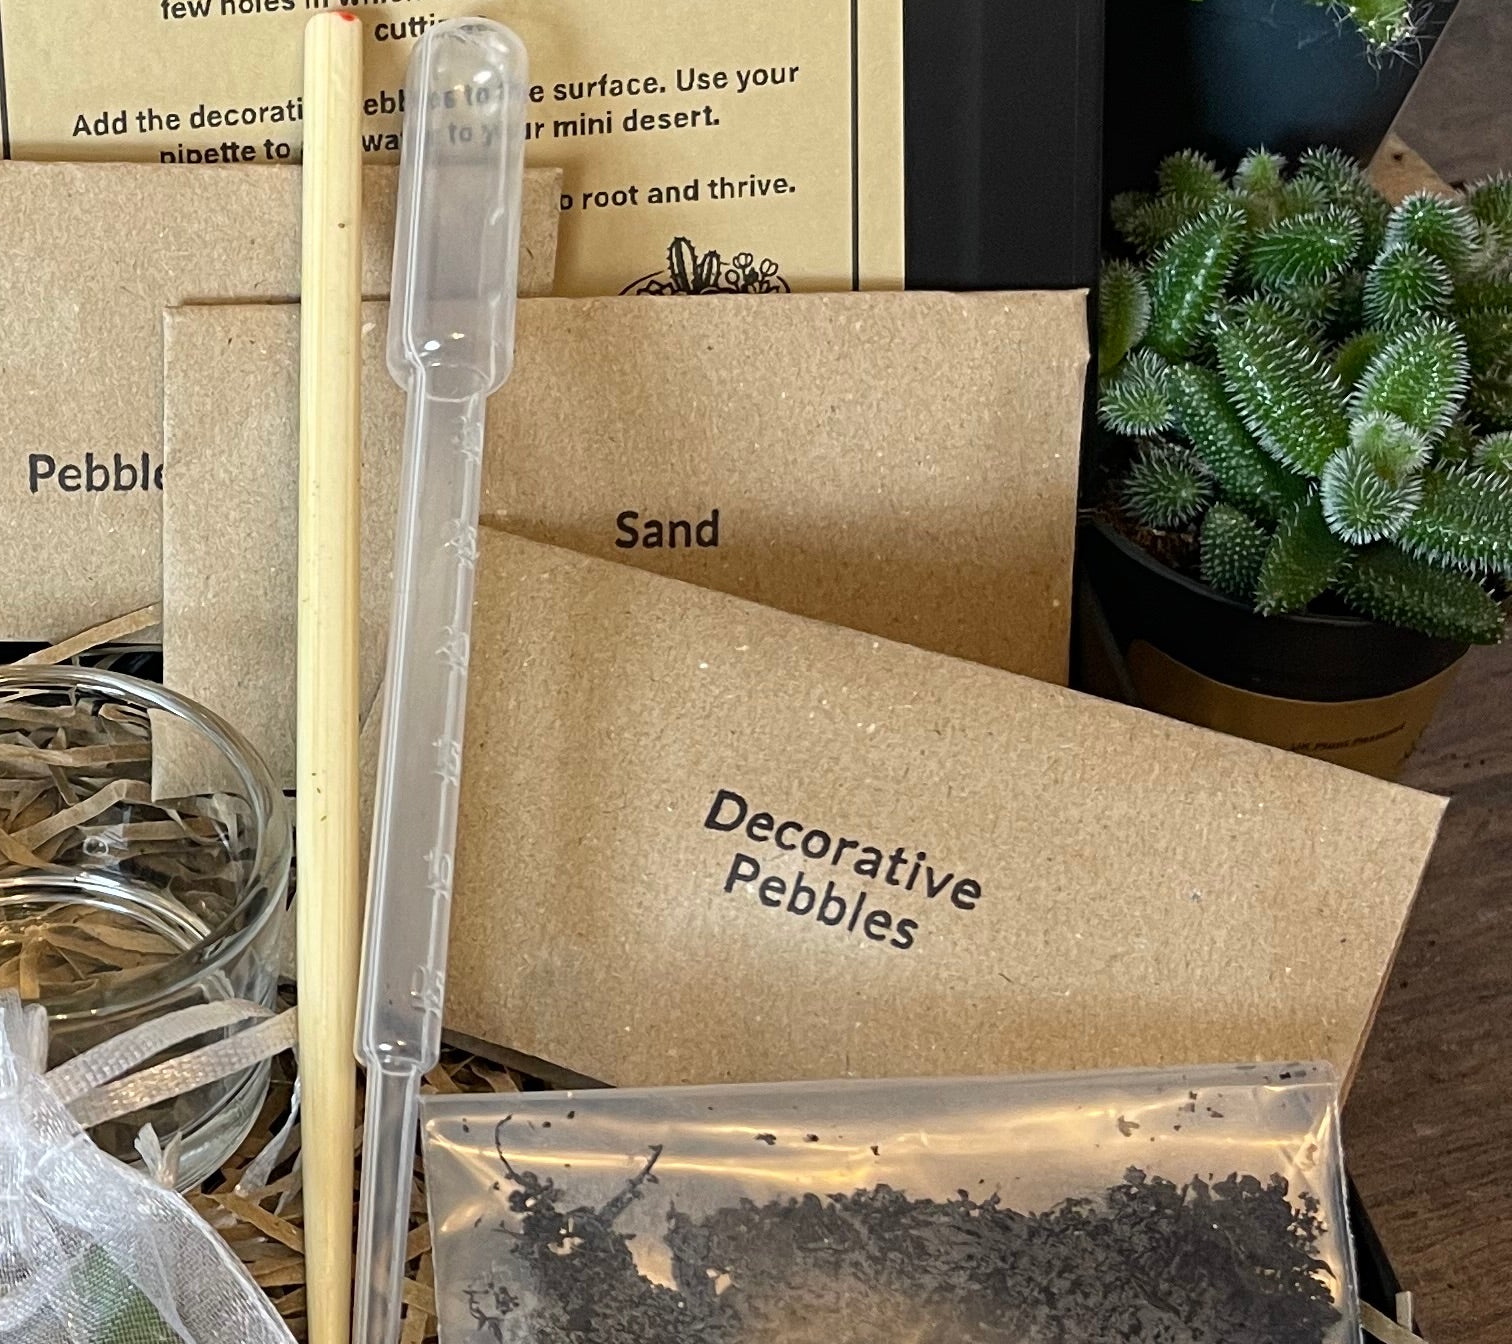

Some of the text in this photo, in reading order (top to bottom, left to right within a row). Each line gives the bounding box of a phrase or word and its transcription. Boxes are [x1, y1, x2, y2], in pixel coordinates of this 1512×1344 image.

[73, 110, 127, 136] Add
[136, 108, 180, 133] the
[190, 98, 303, 130] decorati
[554, 74, 665, 101] surface.
[677, 68, 728, 91] Use
[736, 66, 799, 93] your
[264, 139, 290, 161] to
[554, 111, 612, 137] mini
[623, 106, 719, 132] desert.
[583, 186, 638, 209] root
[648, 179, 698, 203] and
[707, 174, 795, 199] thrive.
[29, 451, 164, 494] Pebbl
[615, 508, 719, 548] Sand
[704, 788, 981, 910] Decorative
[724, 852, 919, 950] Pebbles
